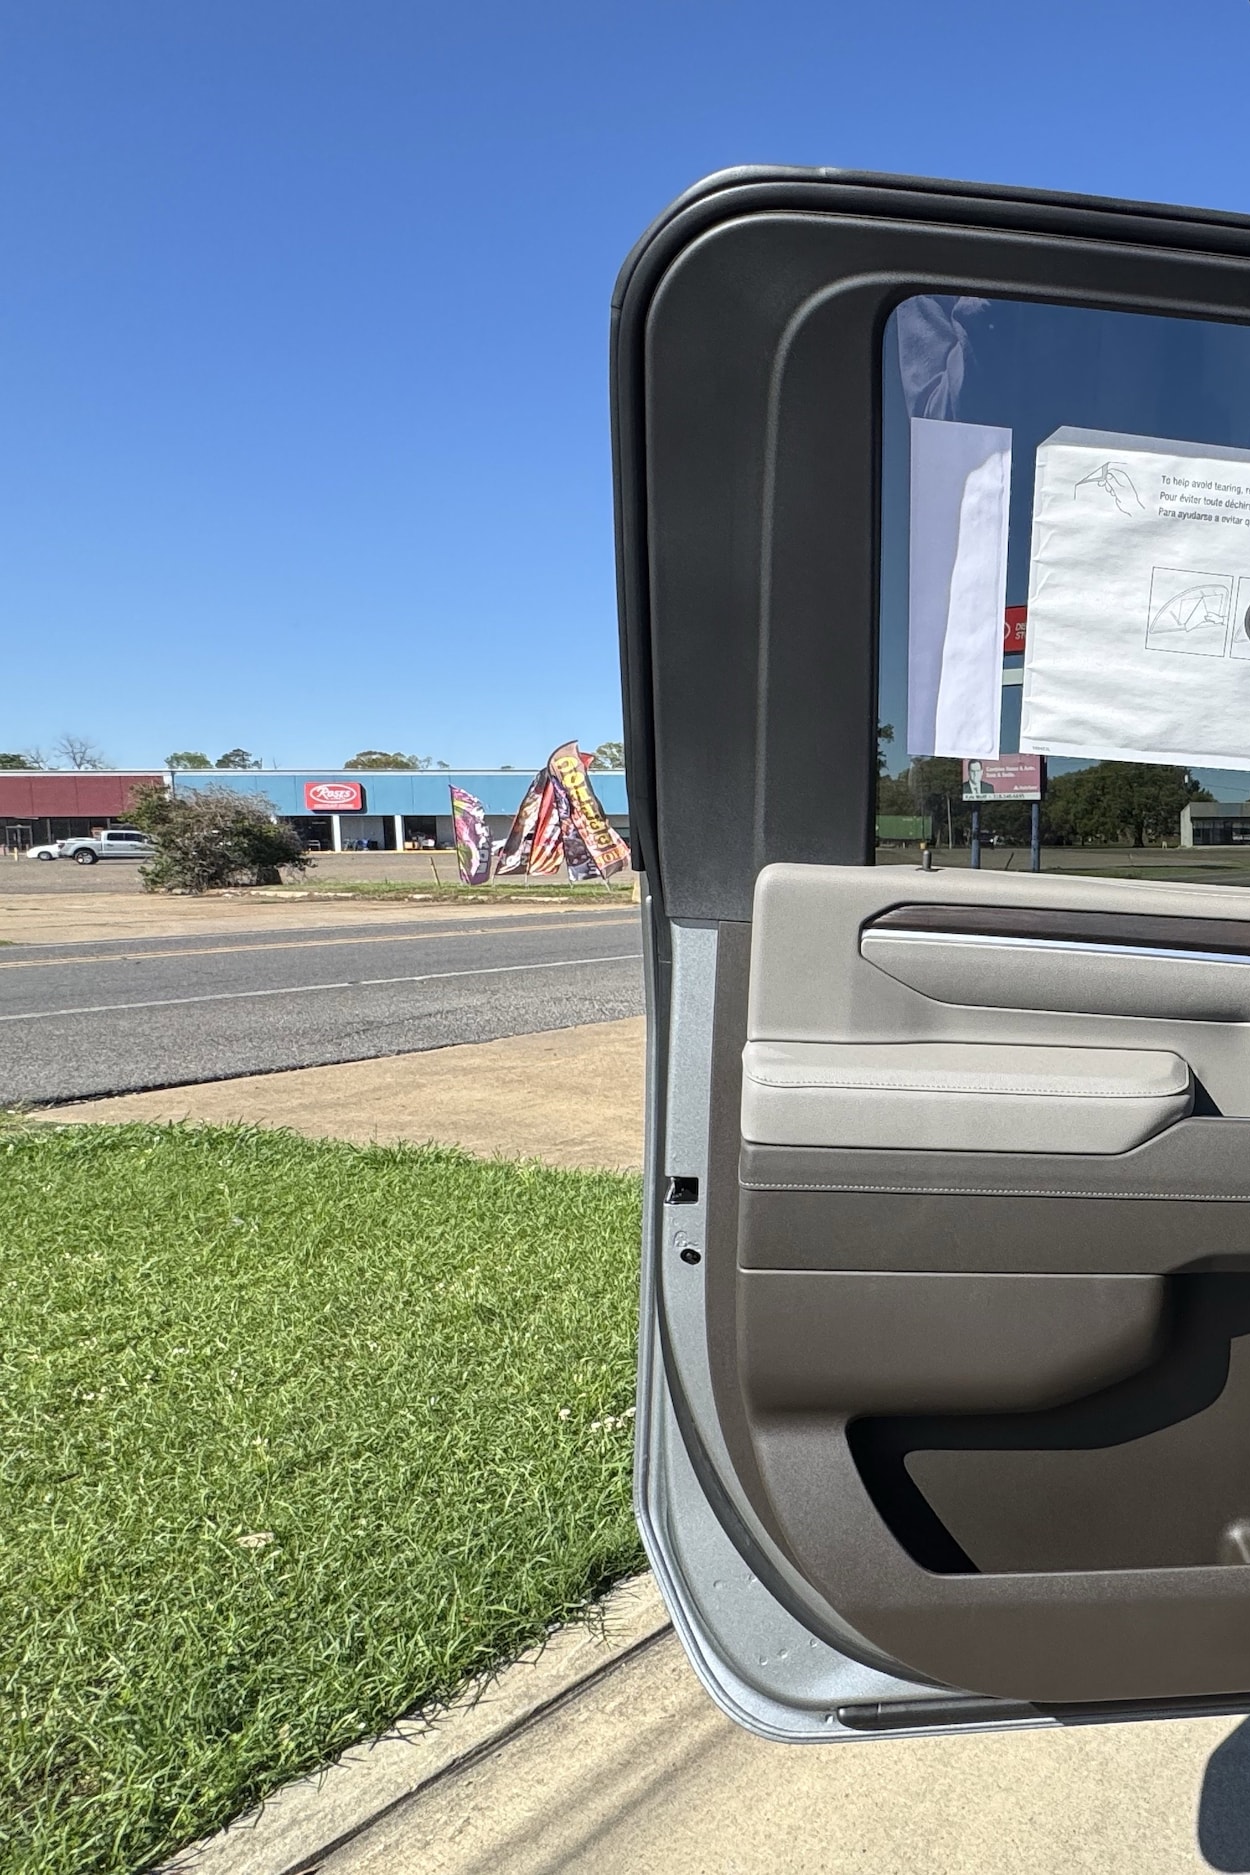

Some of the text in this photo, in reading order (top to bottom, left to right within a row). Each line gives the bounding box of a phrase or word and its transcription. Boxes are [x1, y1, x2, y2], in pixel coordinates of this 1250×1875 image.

[1161, 475, 1171, 485] To
[1173, 476, 1190, 489] help
[1191, 479, 1213, 490] avoid
[1214, 482, 1244, 496] tearing,
[1159, 491, 1177, 502] Pour
[1179, 493, 1202, 505] éviter
[1203, 496, 1223, 507] toute
[1158, 507, 1176, 518] Para
[1177, 511, 1213, 522] ayudarse
[1214, 514, 1220, 523] a
[1221, 515, 1244, 525] evitar
